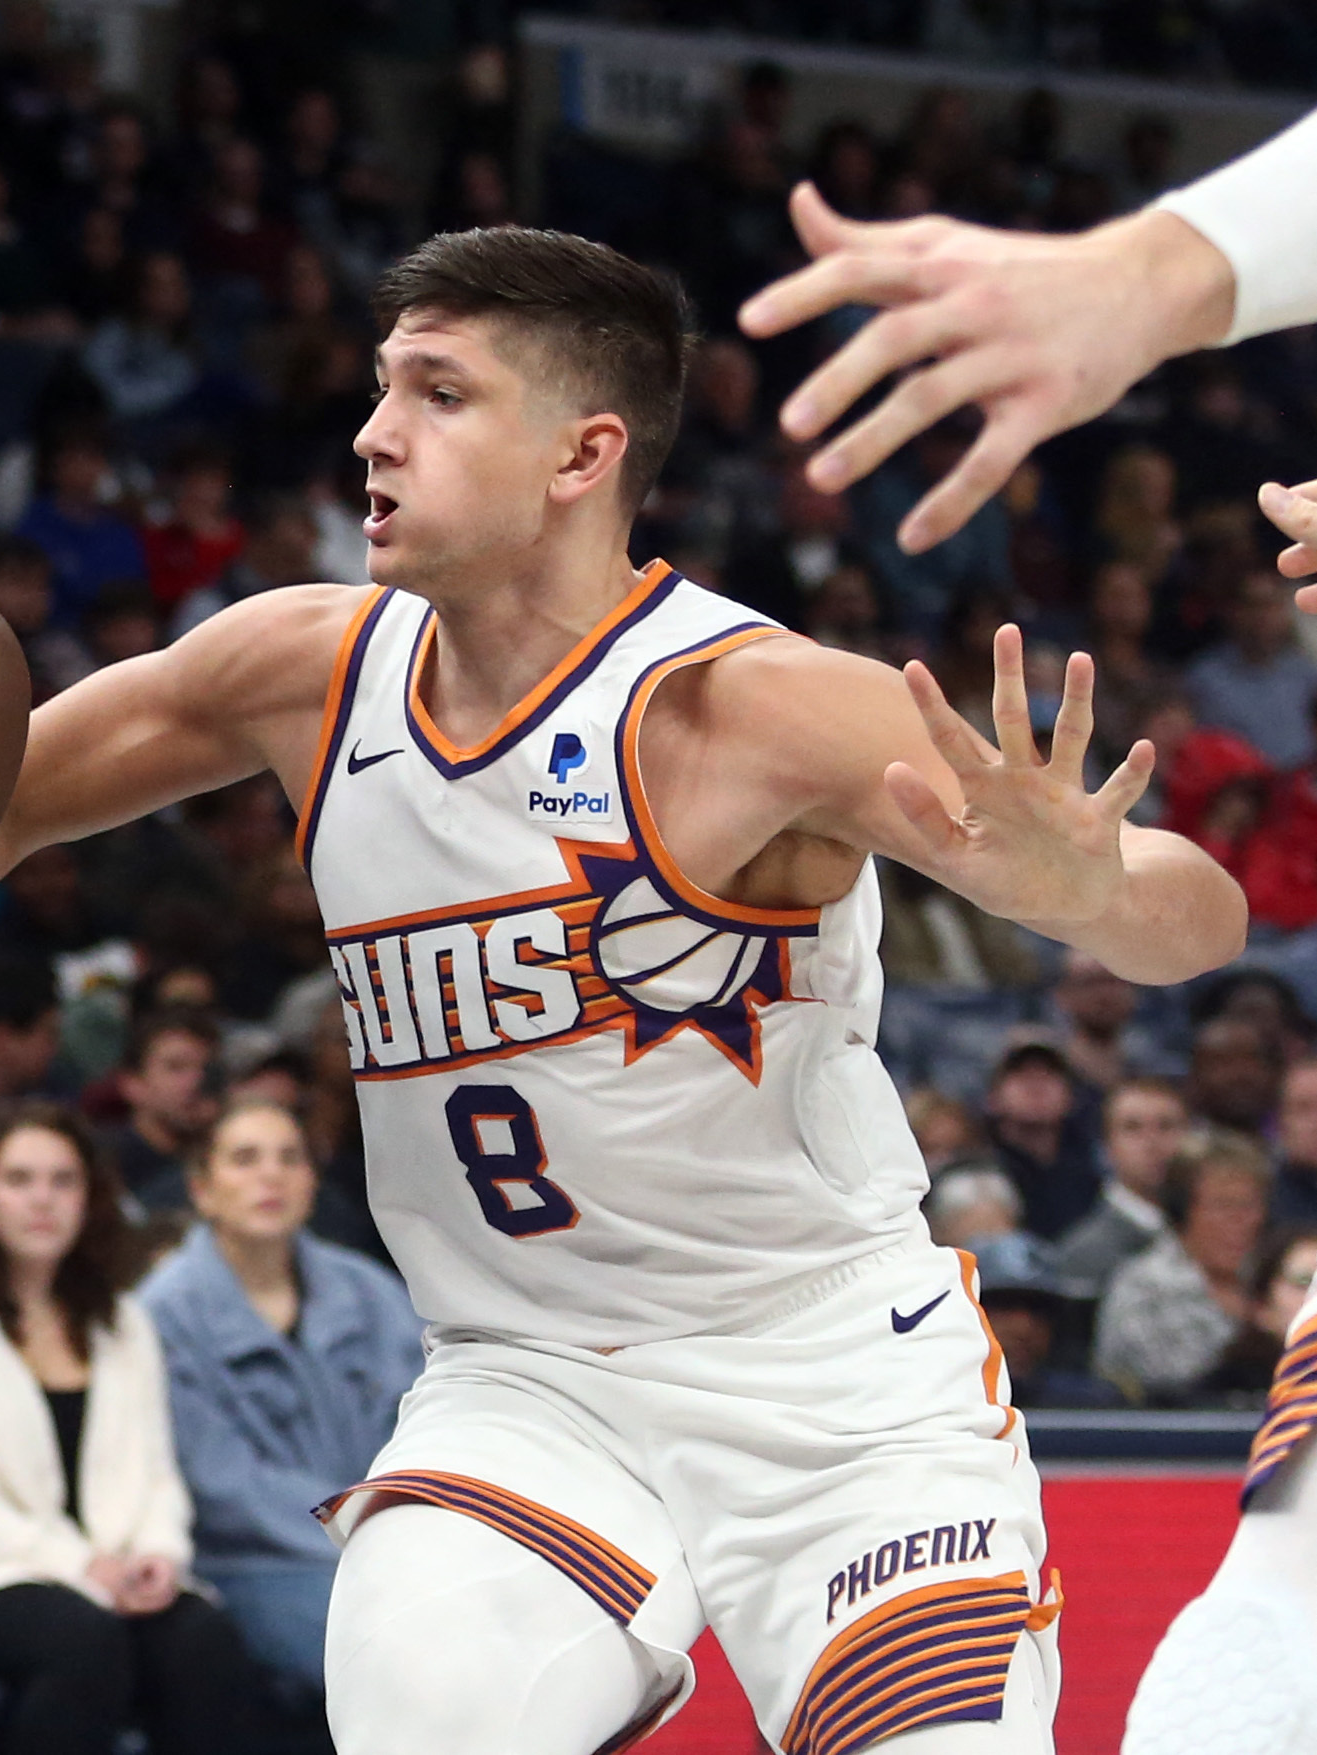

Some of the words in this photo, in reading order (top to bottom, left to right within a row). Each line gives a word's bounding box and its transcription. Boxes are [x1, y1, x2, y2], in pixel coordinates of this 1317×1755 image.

[529, 791, 609, 816] PayPal
[445, 1085, 581, 1239] 8
[827, 1518, 996, 1625] PHOENIX
